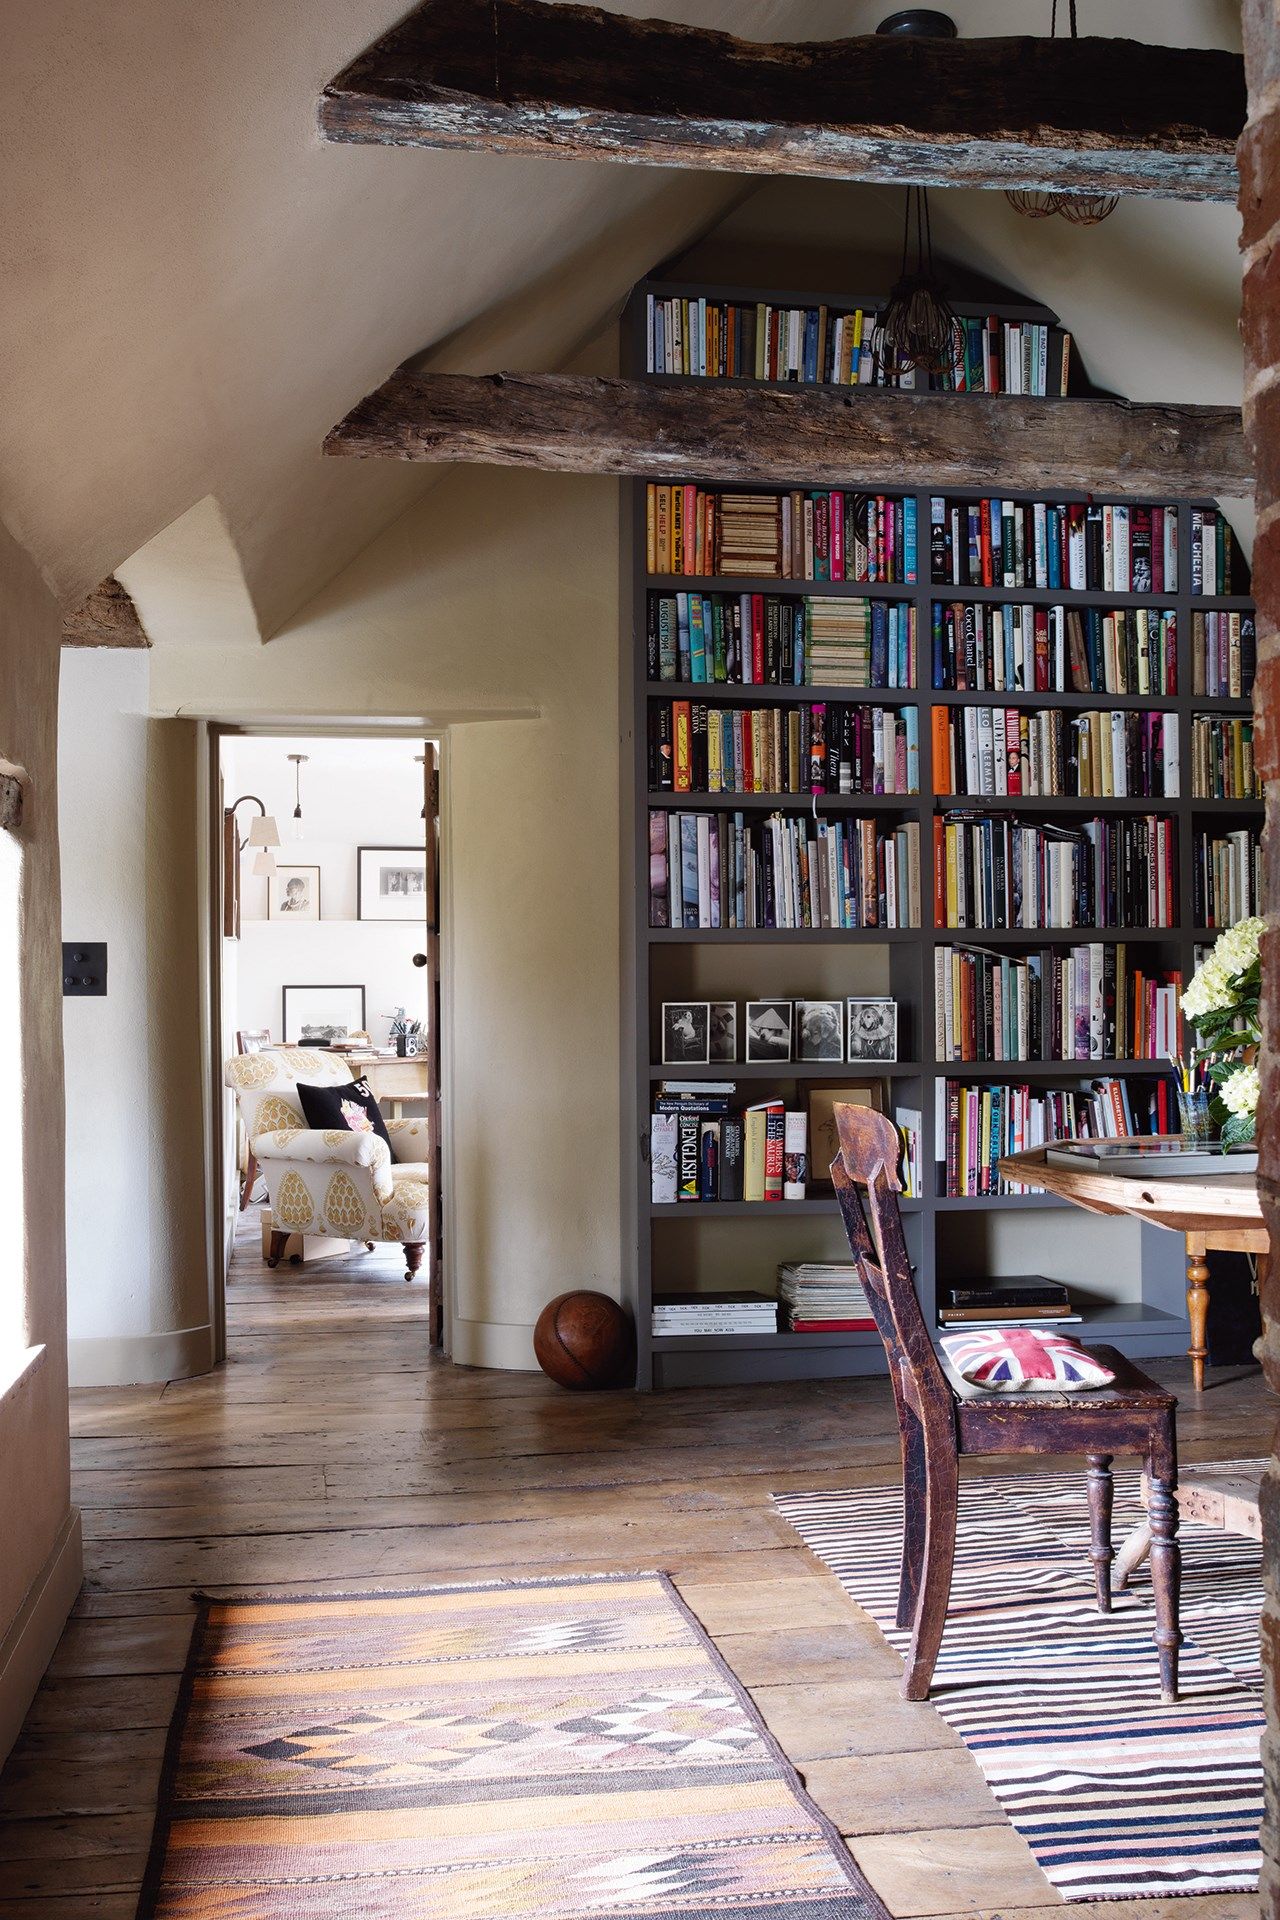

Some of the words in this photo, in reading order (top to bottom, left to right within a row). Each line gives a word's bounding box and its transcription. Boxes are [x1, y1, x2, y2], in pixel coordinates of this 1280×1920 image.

[659, 494, 667, 513] SELF
[659, 514, 667, 535] HELP
[1192, 513, 1202, 531] ME
[1119, 523, 1127, 556] BERLIN
[1192, 542, 1202, 586] CHEETA
[661, 601, 669, 633] AUGUST
[965, 607, 976, 632] Coco
[661, 634, 669, 651] 1914
[965, 632, 976, 667] Chanel
[982, 708, 990, 727] LEO
[1007, 710, 1020, 750] NEWHOUSE
[830, 748, 840, 776] Them
[984, 751, 993, 792] LERMAN
[866, 824, 874, 843] Frank
[866, 844, 874, 876] Auerbach
[937, 955, 945, 970] THE
[937, 970, 945, 998] VILLAS
[985, 972, 993, 993] JOHN
[937, 1000, 945, 1010] OF
[985, 994, 993, 1026] FOWLER
[937, 1012, 945, 1048] TUSCANY
[950, 1096, 959, 1122] PUNK.
[1112, 1087, 1122, 1122] ELIZABETH
[681, 1128, 698, 1180] ENGLISH
[767, 1120, 776, 1174] THESAURUS
[776, 1121, 784, 1173] CHAMBERS
